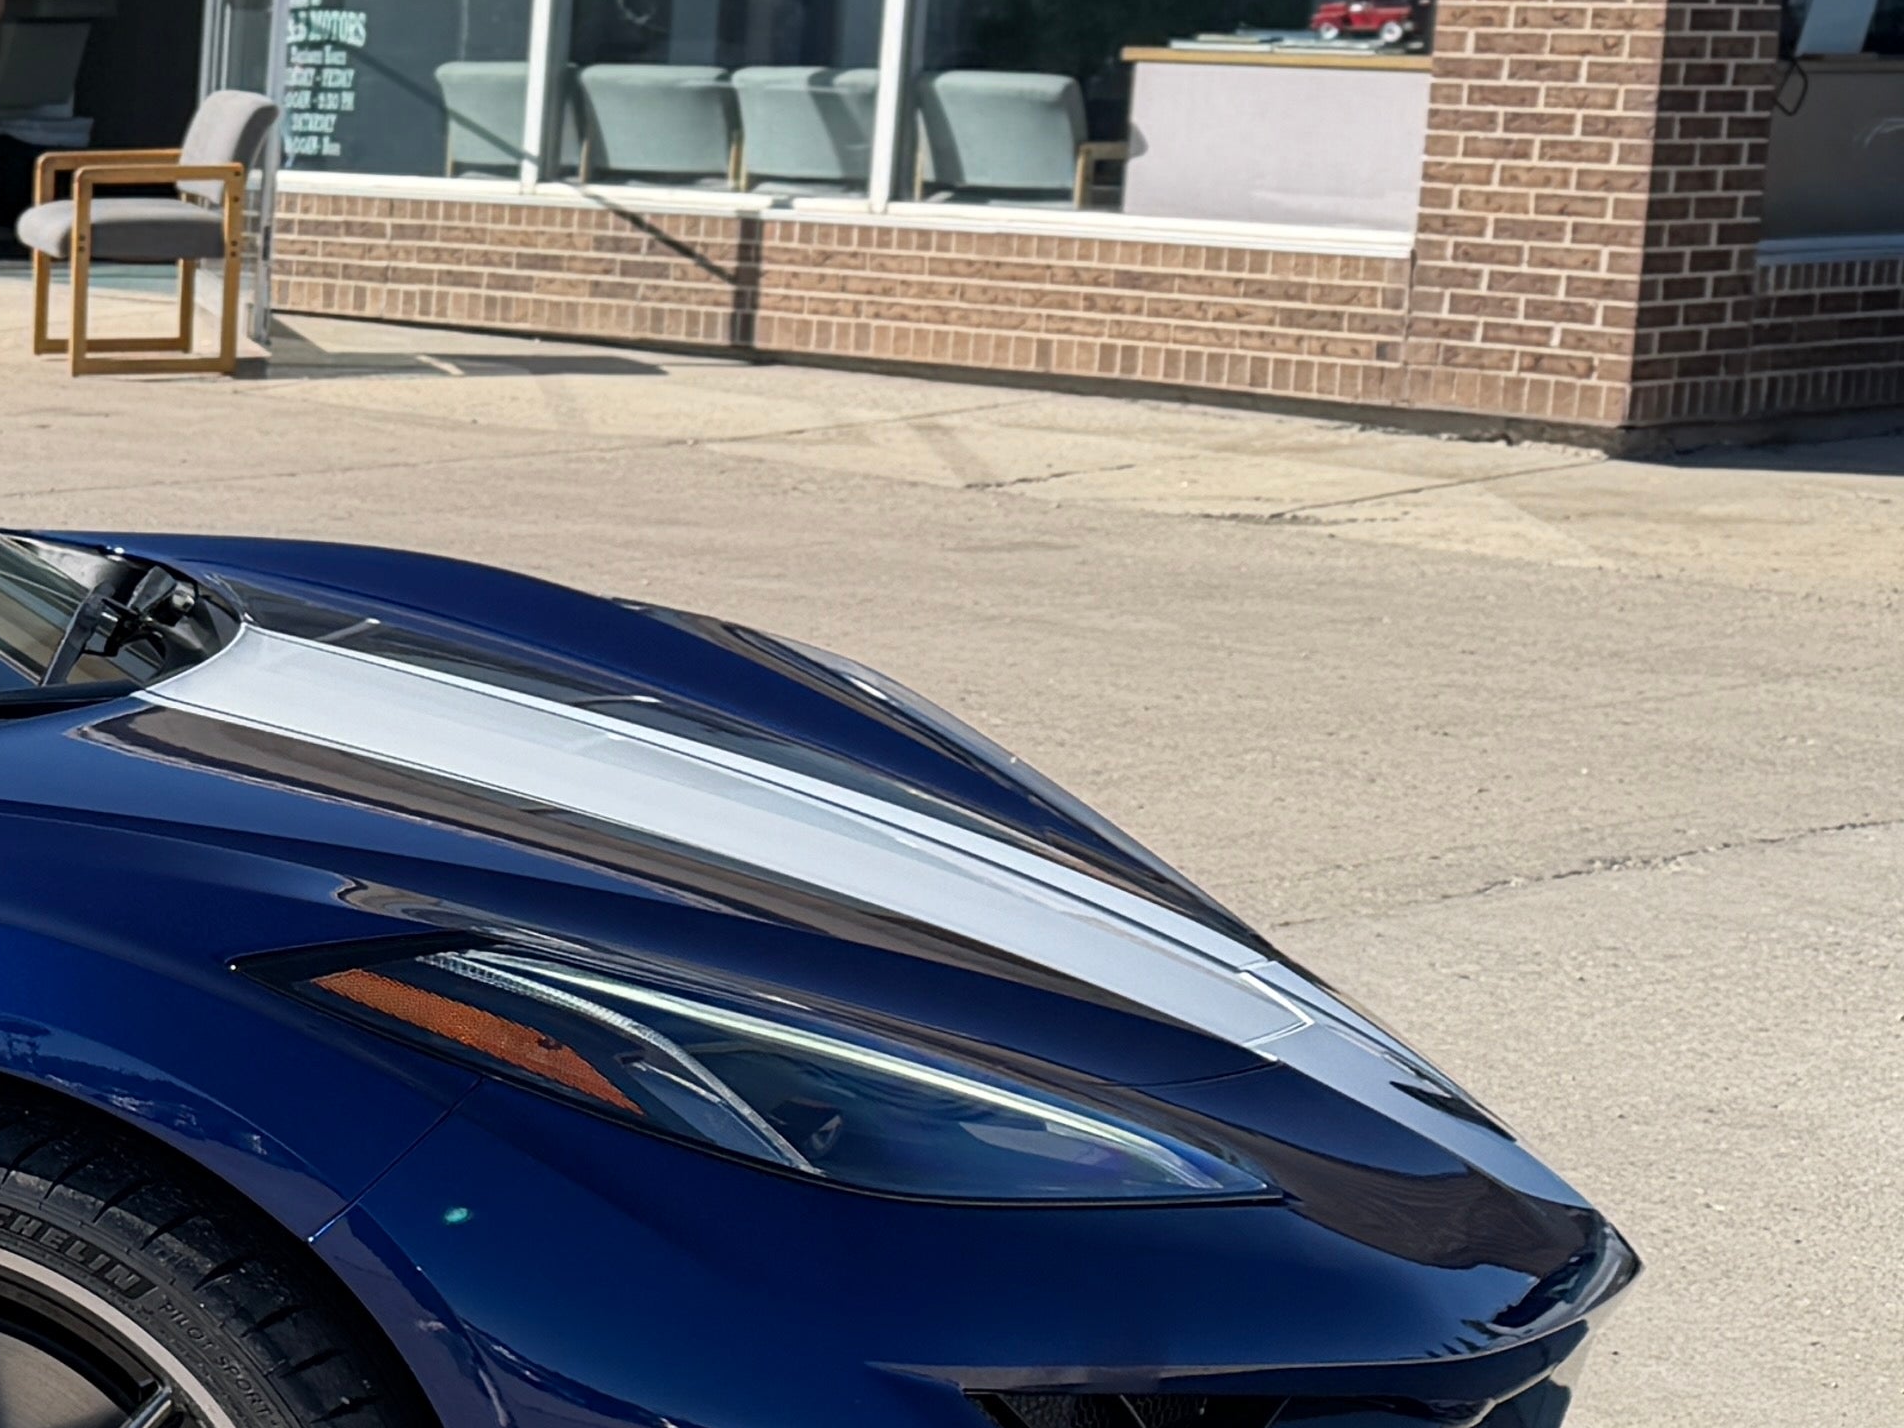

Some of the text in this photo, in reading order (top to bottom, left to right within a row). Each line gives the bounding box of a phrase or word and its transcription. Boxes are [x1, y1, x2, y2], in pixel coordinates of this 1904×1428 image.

[309, 9, 366, 48] MOTORS
[157, 1299, 215, 1352] PILOT
[213, 1353, 272, 1419] SPORT
